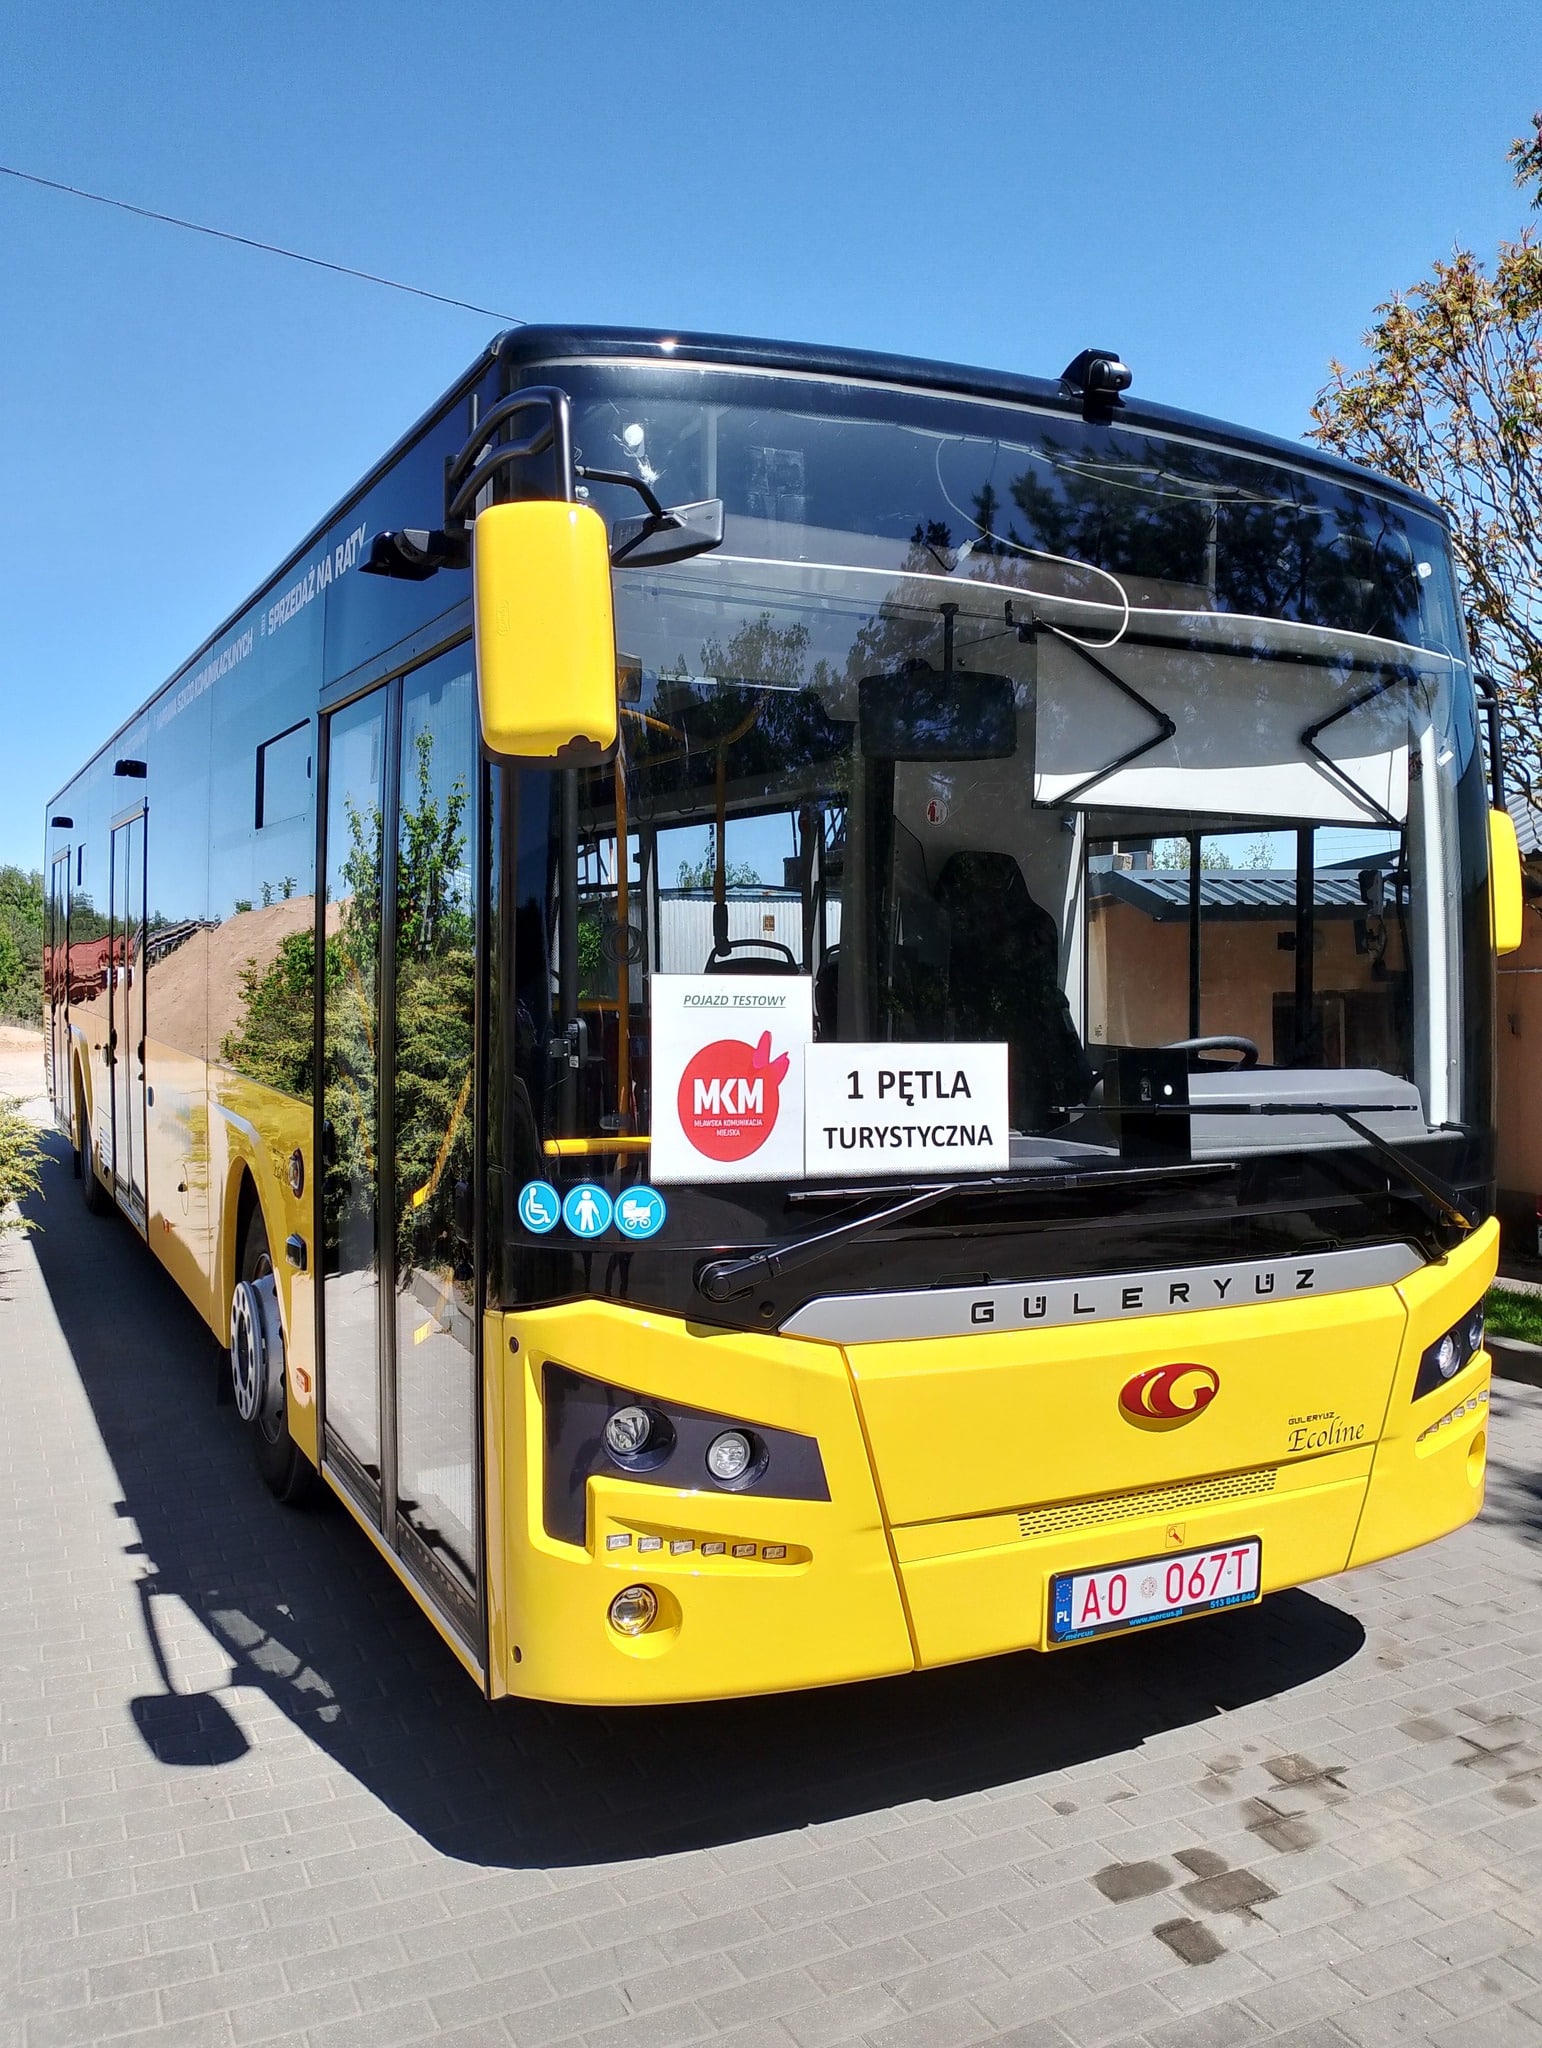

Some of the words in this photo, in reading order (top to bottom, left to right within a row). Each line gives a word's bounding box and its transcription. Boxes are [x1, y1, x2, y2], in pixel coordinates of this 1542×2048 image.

[268, 564, 316, 636] SPRZEDAŻ
[316, 555, 333, 594] NA
[335, 522, 367, 579] RATY
[683, 995, 729, 1007] POJAZD
[732, 995, 786, 1007] TESTOWY
[694, 1078, 764, 1115] MKM
[847, 1070, 864, 1099] 1
[878, 1070, 972, 1106] PĘTLA
[694, 1119, 722, 1127] MŁAWSKA
[723, 1119, 763, 1127] KOMUNIKACJA
[716, 1129, 741, 1137] MIEJSKA
[822, 1125, 993, 1149] TURYSTYCZNA
[970, 1268, 1315, 1324] GÜLERYÜZ
[1287, 1415, 1365, 1452] Ecoline
[1165, 1548, 1250, 1604] 067T
[1210, 1598, 1225, 1609] 513
[1056, 1611, 1070, 1624] PL
[1128, 1607, 1183, 1626] www.mercus.pl
[1065, 1630, 1095, 1641] mercus
